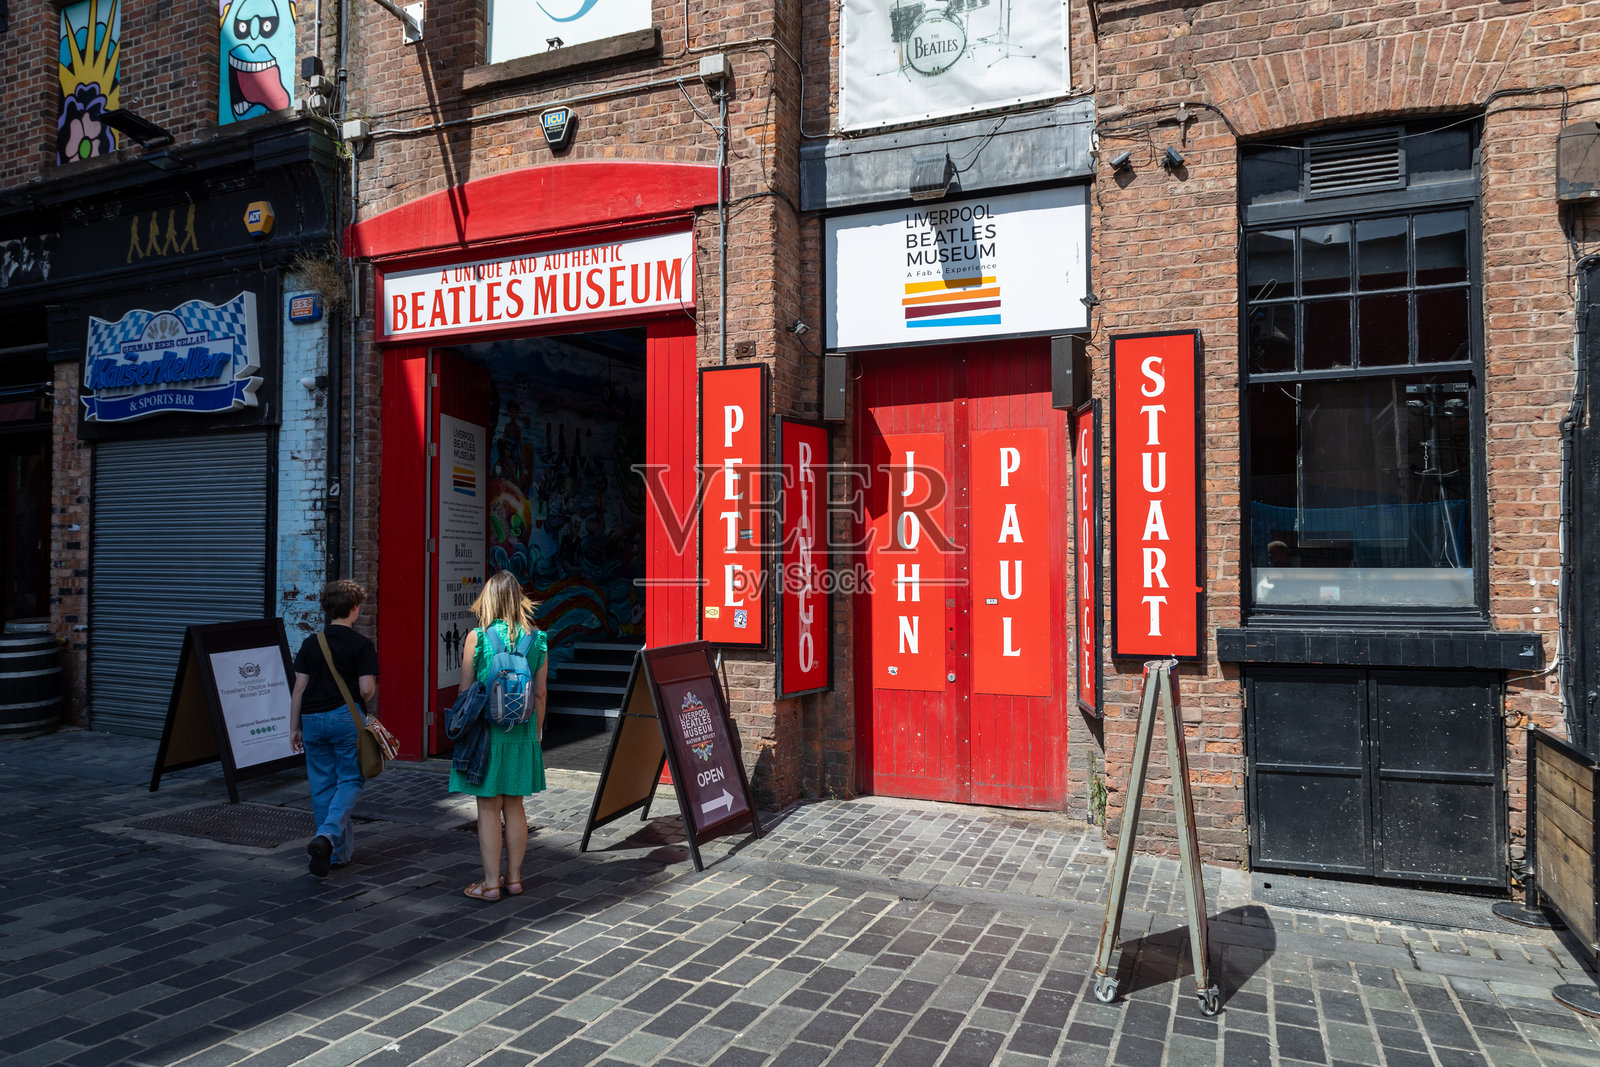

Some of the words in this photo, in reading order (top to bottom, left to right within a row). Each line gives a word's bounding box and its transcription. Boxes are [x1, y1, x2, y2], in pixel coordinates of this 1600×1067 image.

[914, 38, 962, 62] BEATLES
[548, 114, 562, 125] ICU
[249, 211, 260, 222] ADT
[906, 203, 994, 229] LIVERPOOL
[906, 224, 997, 249] BEATLES
[441, 269, 448, 285] A
[454, 260, 502, 284] UNIQUE
[509, 256, 538, 276] AND
[544, 244, 623, 272] AUTHENTIC
[906, 242, 996, 267] MUSEUM
[916, 269, 933, 277] Fab
[945, 263, 997, 276] Experience
[392, 278, 524, 332] BEATLES
[533, 257, 682, 316] MUSEUM
[122, 342, 153, 354] GERMAN
[154, 340, 175, 351] BEER
[176, 336, 206, 347] CELLAR
[88, 347, 232, 390] Kaiserkeller
[130, 401, 138, 412] &
[138, 393, 174, 409] SPORTS
[175, 394, 194, 406] BAR
[454, 427, 475, 443] LIVERPOOL
[454, 438, 476, 452] BEATLES
[454, 449, 476, 463] MUSEUM
[720, 404, 744, 608] PETE
[1140, 356, 1170, 636] STUART
[455, 544, 473, 558] BEATLES
[798, 441, 814, 674] RINGO
[896, 450, 921, 654] JOHN
[998, 446, 1024, 658] PAUL
[1081, 428, 1092, 690] GEORGE
[454, 592, 468, 607] ROLL
[678, 708, 710, 722] LIVERPOOL
[680, 715, 712, 730] BEATLES
[683, 723, 713, 739] MUSEUM
[686, 736, 702, 745] MATHEW
[697, 766, 724, 788] OPEN
